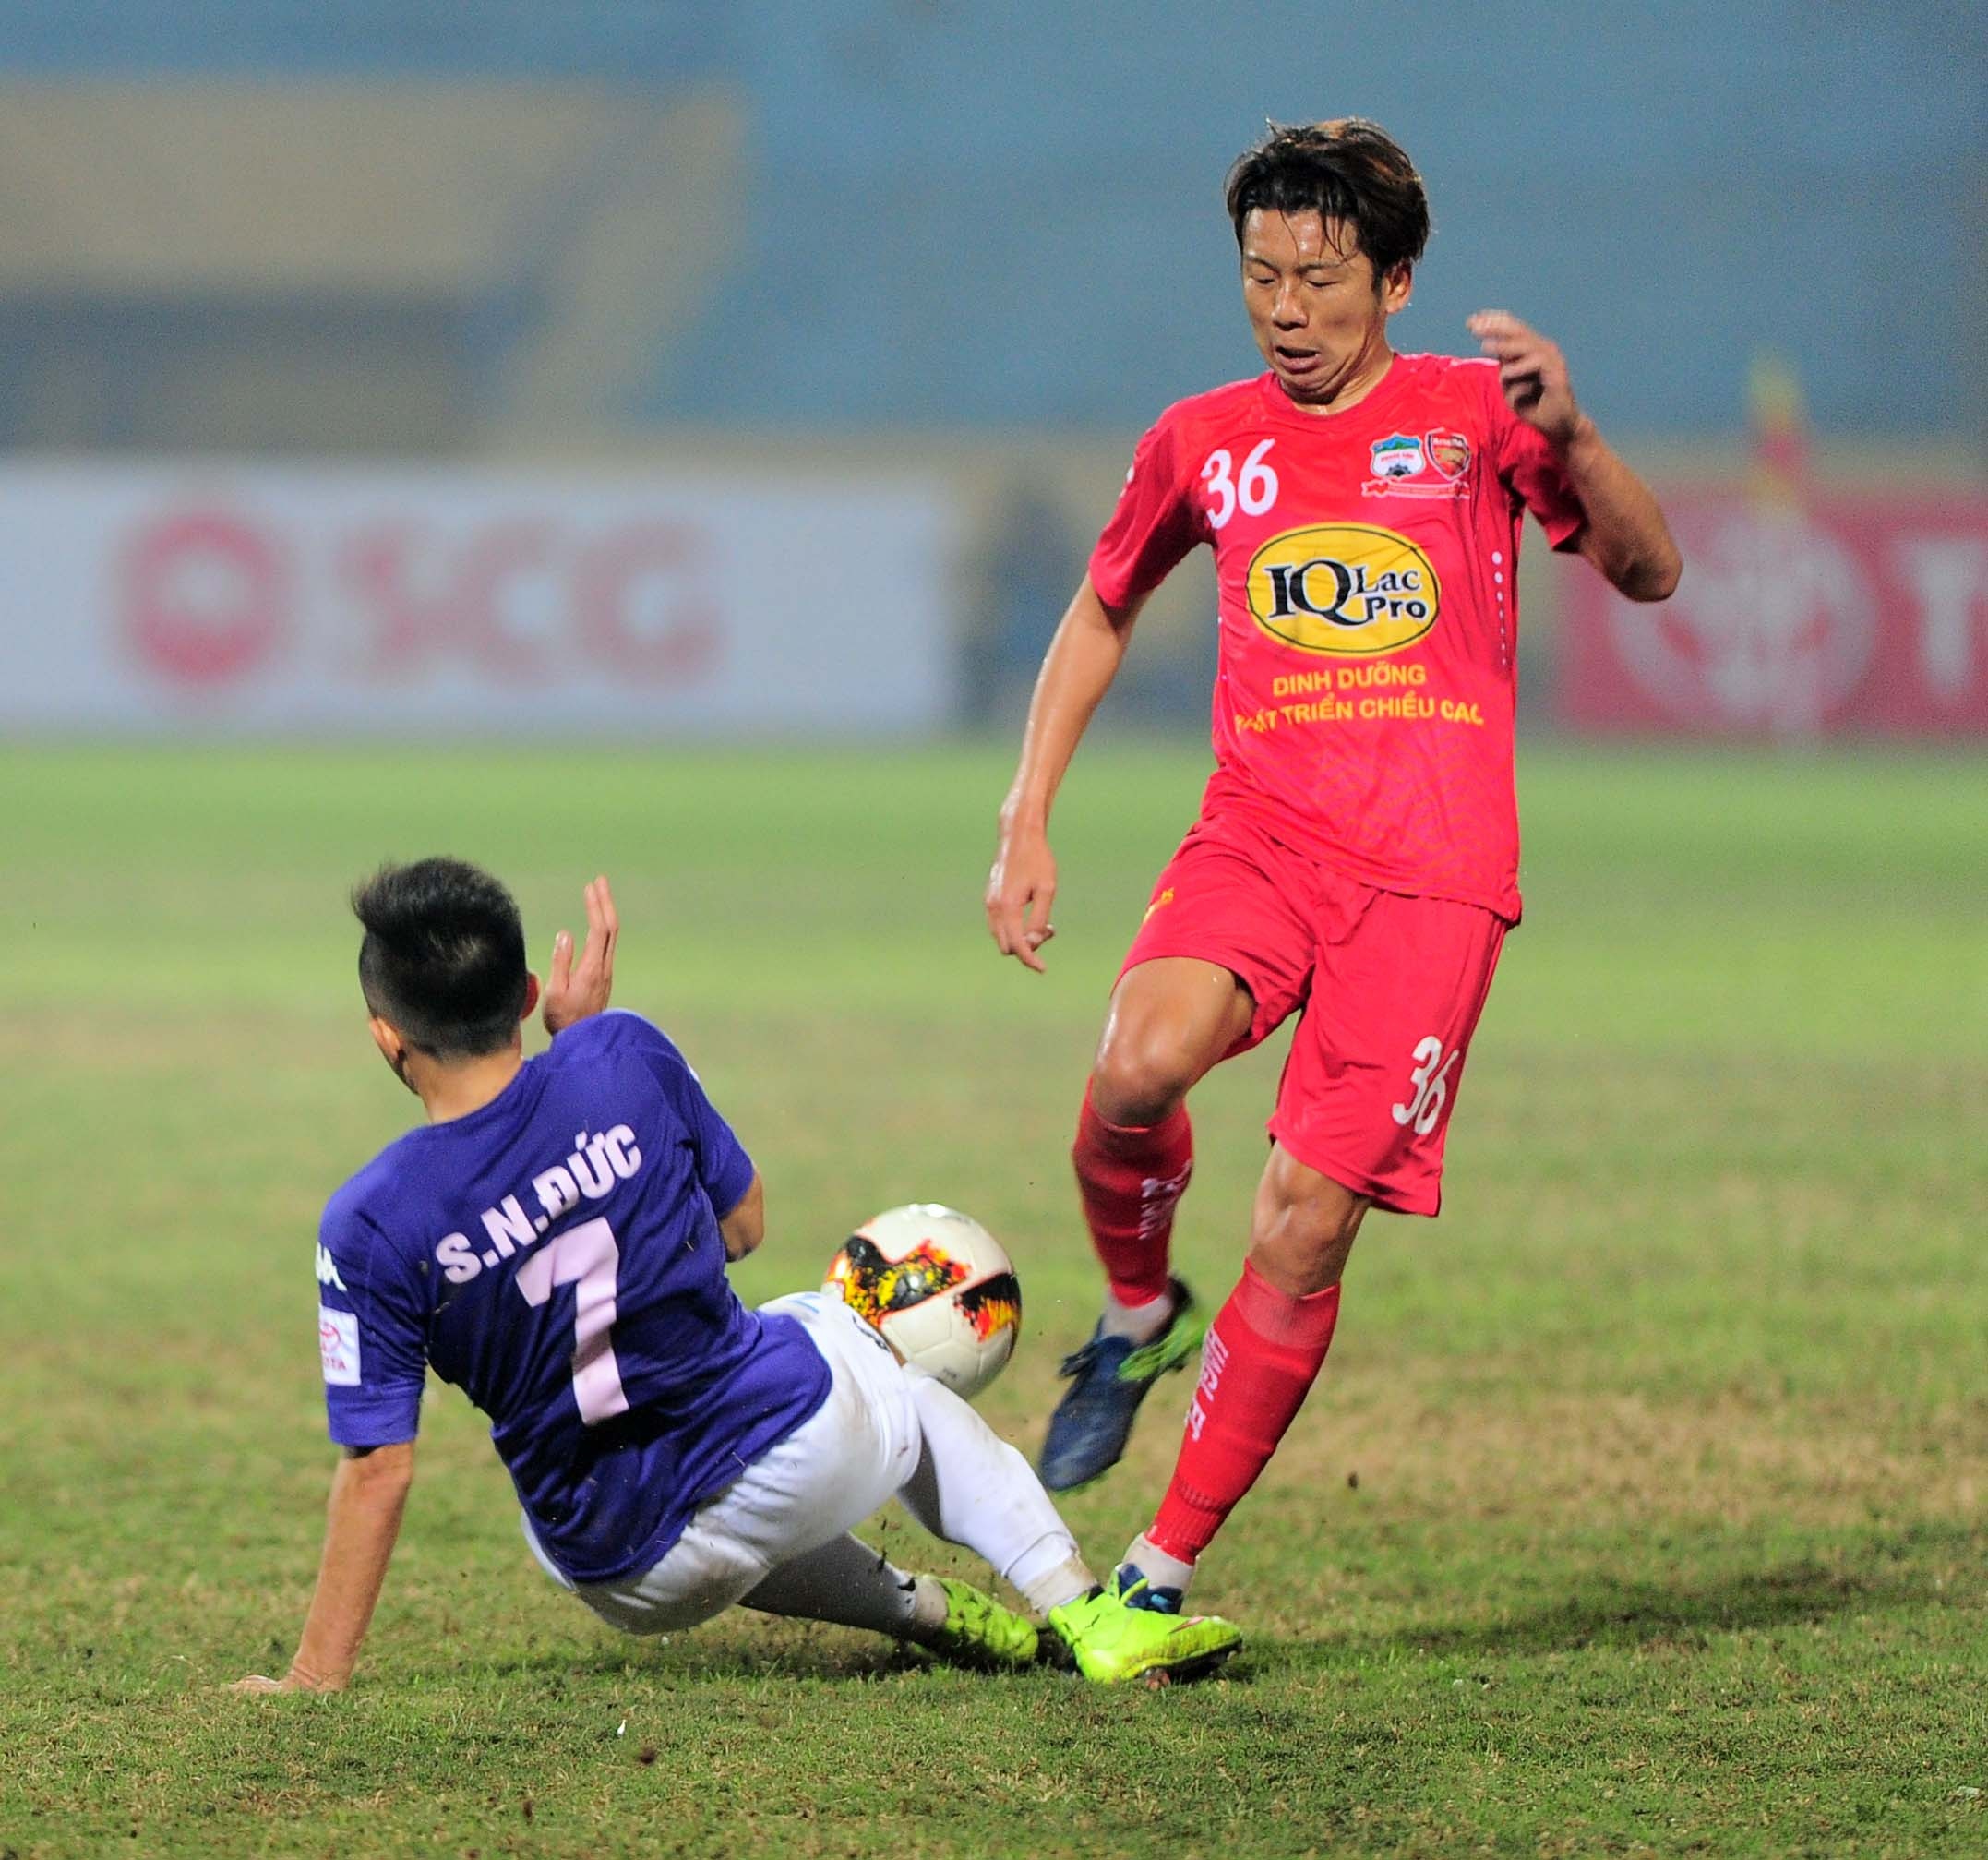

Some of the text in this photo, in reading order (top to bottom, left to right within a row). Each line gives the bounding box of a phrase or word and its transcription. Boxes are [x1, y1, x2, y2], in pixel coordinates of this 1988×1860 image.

[1201, 438, 1278, 529] 36
[1264, 559, 1420, 626] IQ Lac
[1364, 595, 1428, 619] Pro
[1273, 669, 1333, 697] DINH
[1392, 1036, 1458, 1135] 36
[514, 1216, 630, 1425] 7
